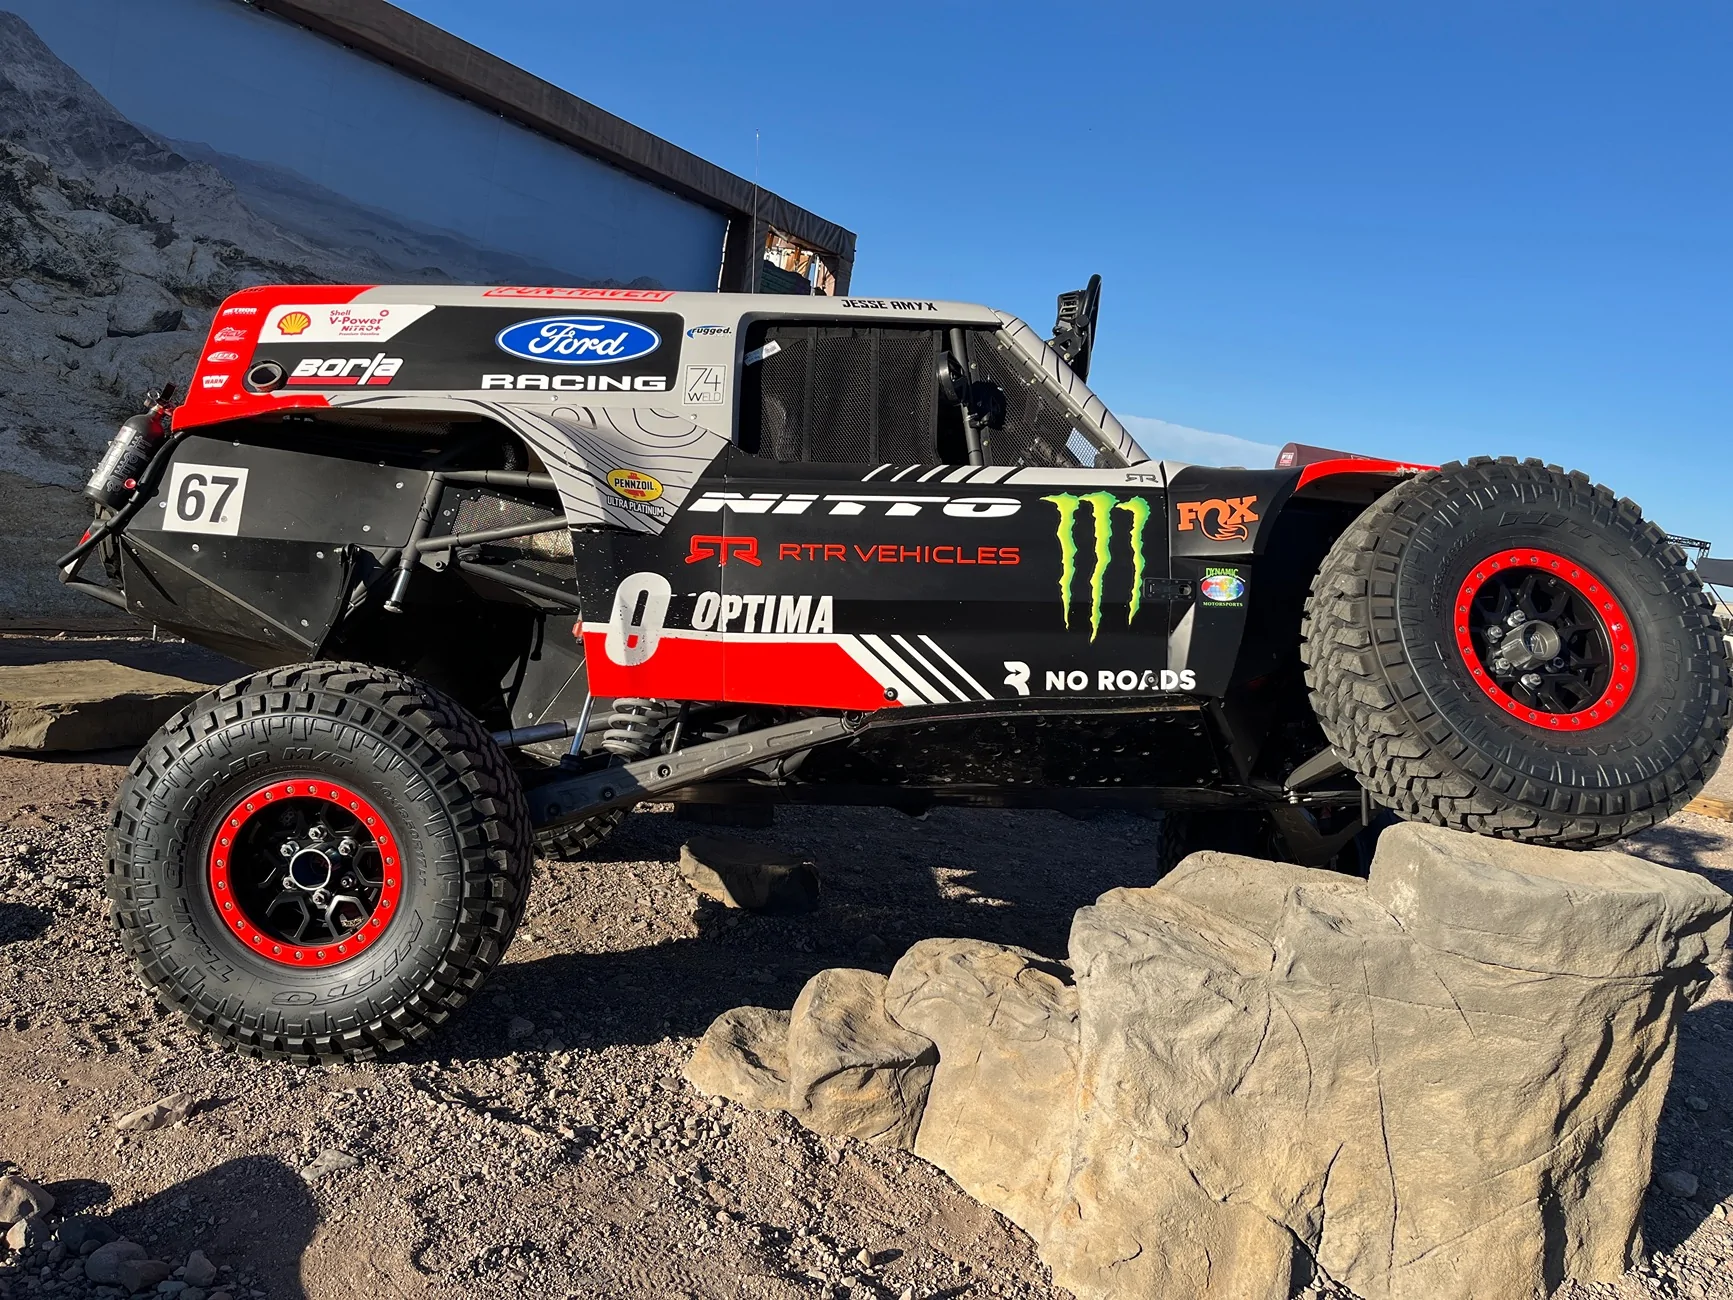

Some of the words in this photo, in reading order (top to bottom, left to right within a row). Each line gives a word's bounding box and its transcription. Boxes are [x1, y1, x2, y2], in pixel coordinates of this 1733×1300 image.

[841, 299, 888, 309] JESSE
[889, 301, 938, 311] AMYX
[329, 316, 383, 325] V-Power
[528, 322, 628, 356] Ford
[481, 374, 666, 391] RACING
[689, 367, 721, 392] 74
[687, 392, 721, 401] WELD
[614, 478, 655, 490] PENNZOIL
[176, 473, 239, 523] 67
[607, 495, 628, 509] ULTRA
[629, 502, 664, 517] PLATINUM
[687, 491, 1022, 518] NITTO
[1176, 495, 1259, 542] FOX
[779, 543, 847, 561] RTR
[854, 545, 1021, 565] VEHICLES
[1205, 567, 1239, 578] DYNAMIC
[692, 590, 834, 633] OPTIMA
[1045, 670, 1089, 691] NO
[1098, 670, 1196, 692] ROADS
[282, 746, 353, 768] M/T
[162, 749, 272, 889] GRAPPLER
[171, 897, 235, 984] TRAIL
[271, 908, 424, 1008] NITTO
